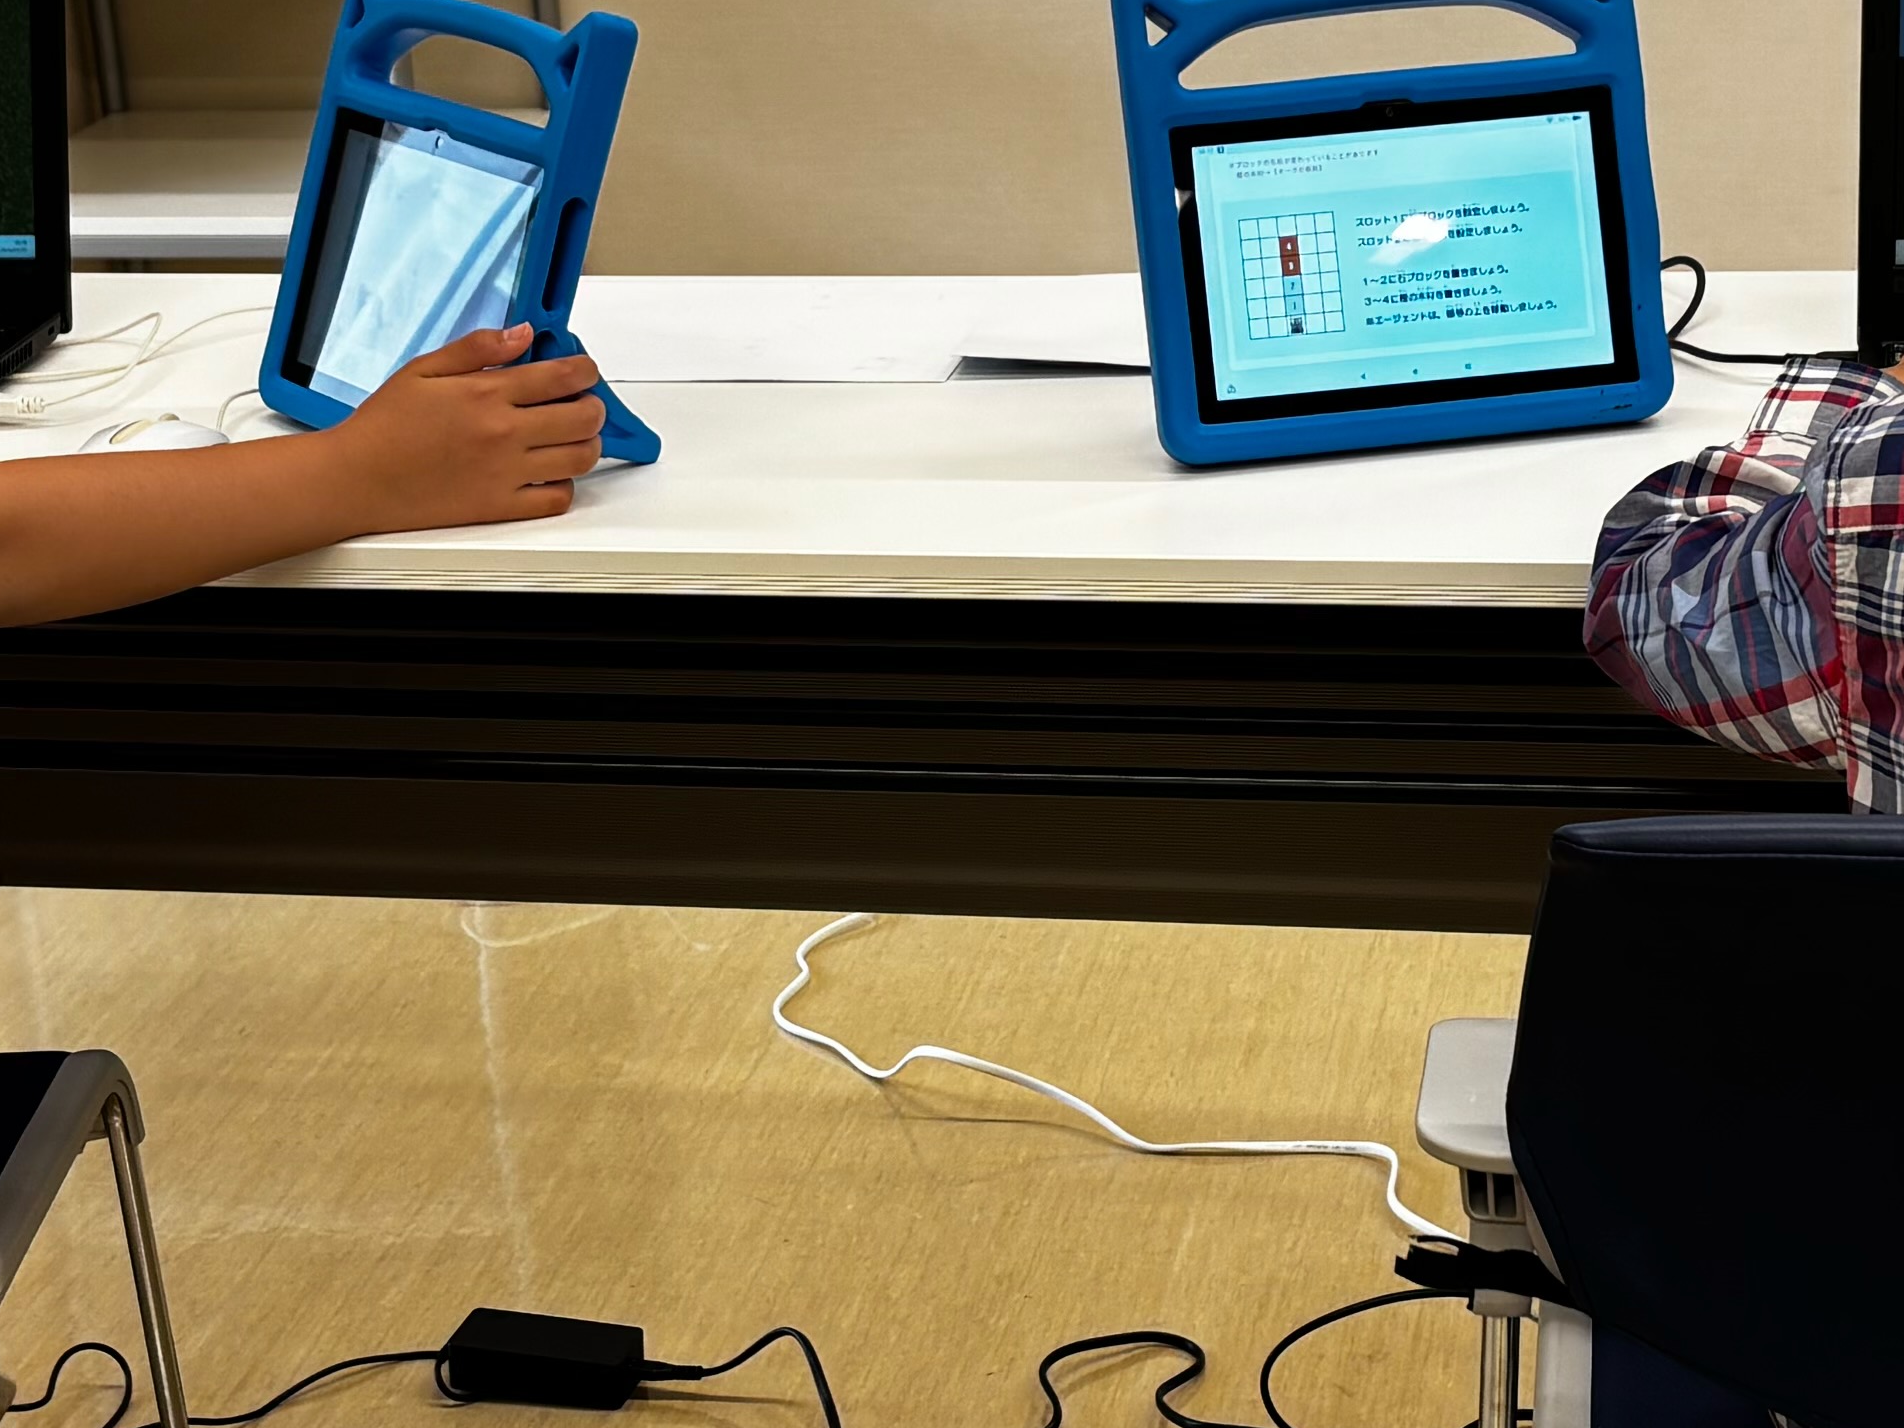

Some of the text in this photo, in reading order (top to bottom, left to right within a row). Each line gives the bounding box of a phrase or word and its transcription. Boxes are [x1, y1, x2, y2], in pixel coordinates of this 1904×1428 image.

[1355, 202, 1530, 228] スロット1にロックを設定しましょう。
[1357, 223, 1523, 247] スロットを設定しましょう。
